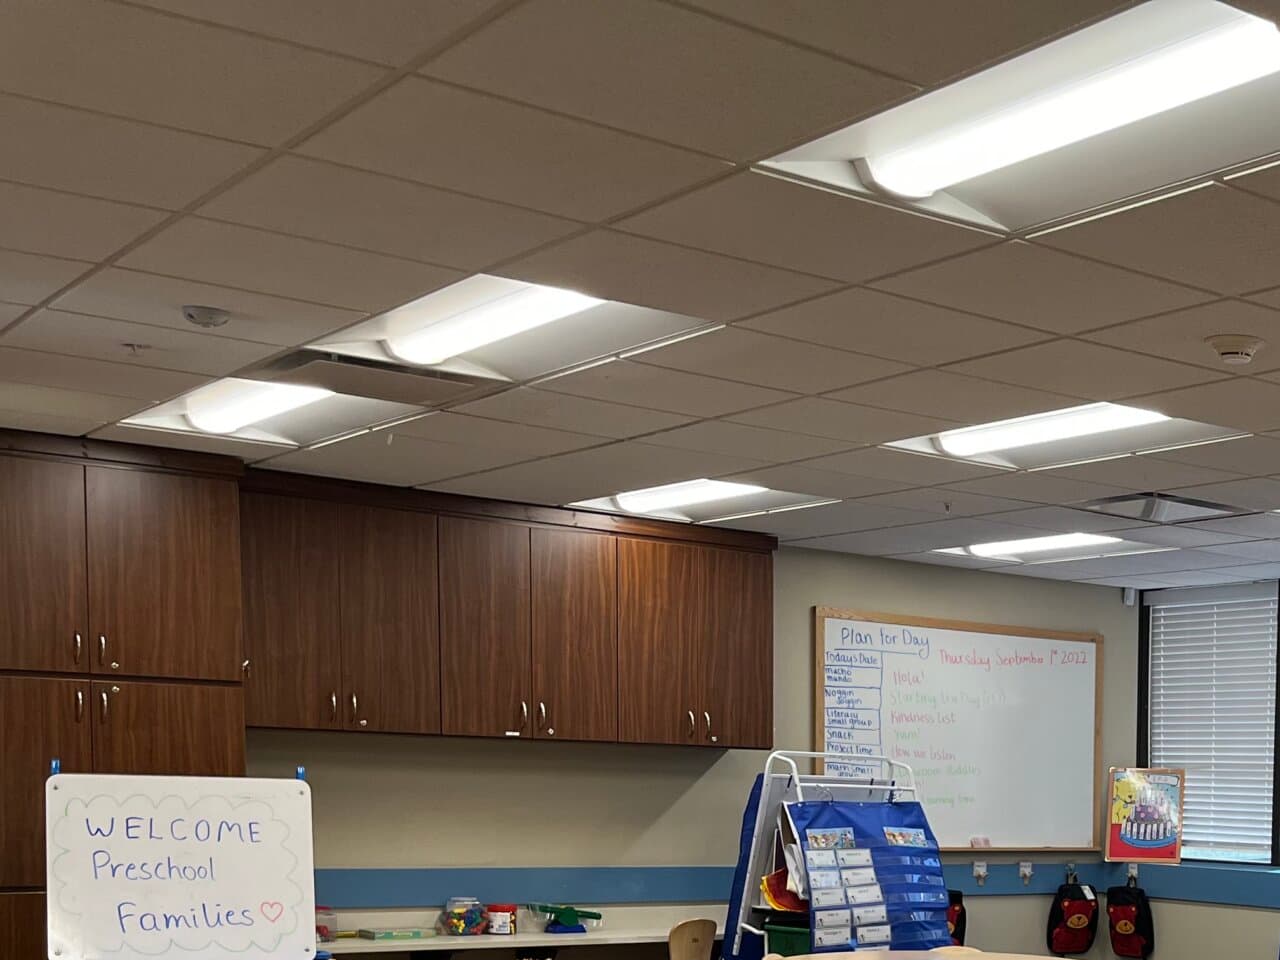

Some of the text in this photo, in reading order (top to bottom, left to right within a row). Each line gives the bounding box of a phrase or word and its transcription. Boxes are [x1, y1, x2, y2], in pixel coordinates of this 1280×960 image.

[841, 627, 930, 660] Plan for Day
[939, 649, 991, 672] Thursday
[1061, 651, 1088, 665] 2022
[827, 730, 853, 741] Snack
[86, 816, 262, 842] WELCOME
[92, 850, 216, 880] Preschool
[117, 902, 254, 933] Families
